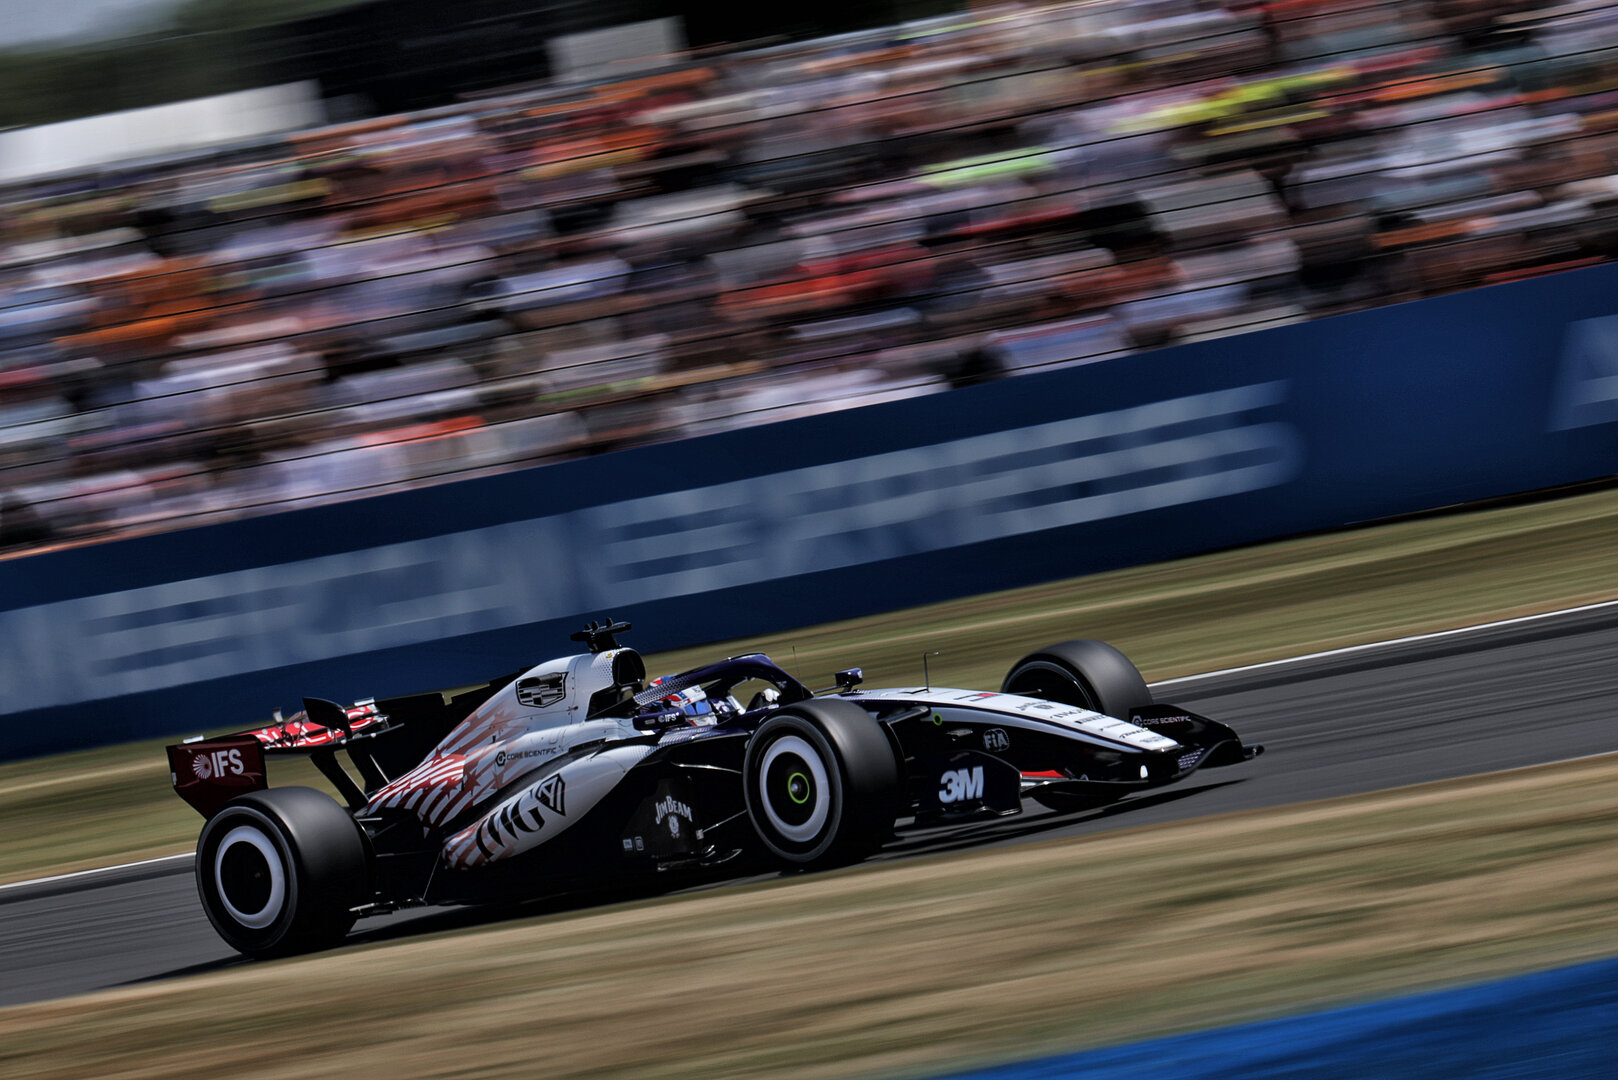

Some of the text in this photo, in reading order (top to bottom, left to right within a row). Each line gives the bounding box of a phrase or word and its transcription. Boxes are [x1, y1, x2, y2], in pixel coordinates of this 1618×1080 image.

[210, 748, 245, 778] IFS
[506, 747, 557, 761] CORE SCIENTIFIC
[938, 765, 984, 804] 3M
